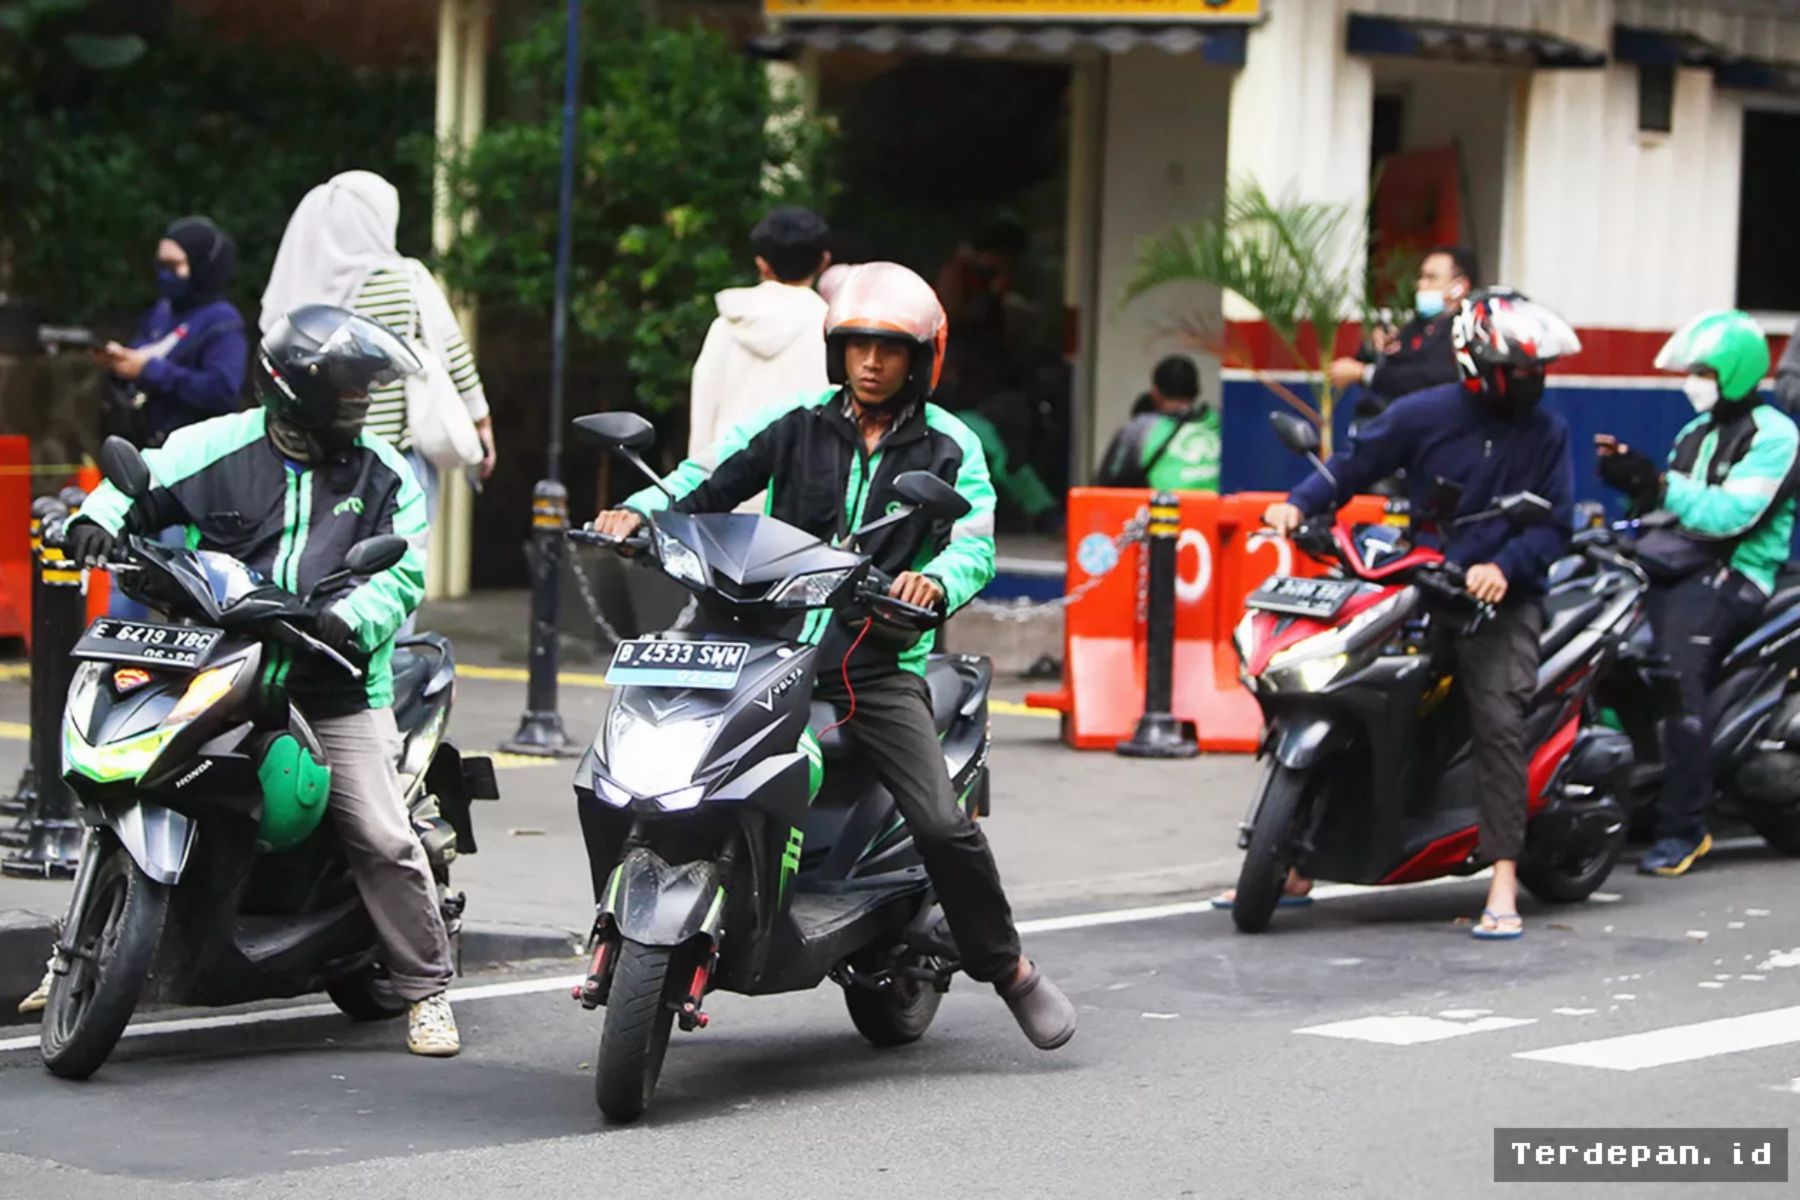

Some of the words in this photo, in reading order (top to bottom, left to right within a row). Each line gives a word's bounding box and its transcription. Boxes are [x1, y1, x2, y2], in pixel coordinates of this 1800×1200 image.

[92, 623, 109, 639] E
[116, 625, 167, 644] 6419
[173, 631, 211, 649] YBC
[618, 643, 635, 662] B
[640, 643, 694, 663] 4533
[772, 668, 803, 694] VOLTA
[176, 760, 213, 788] HONDA
